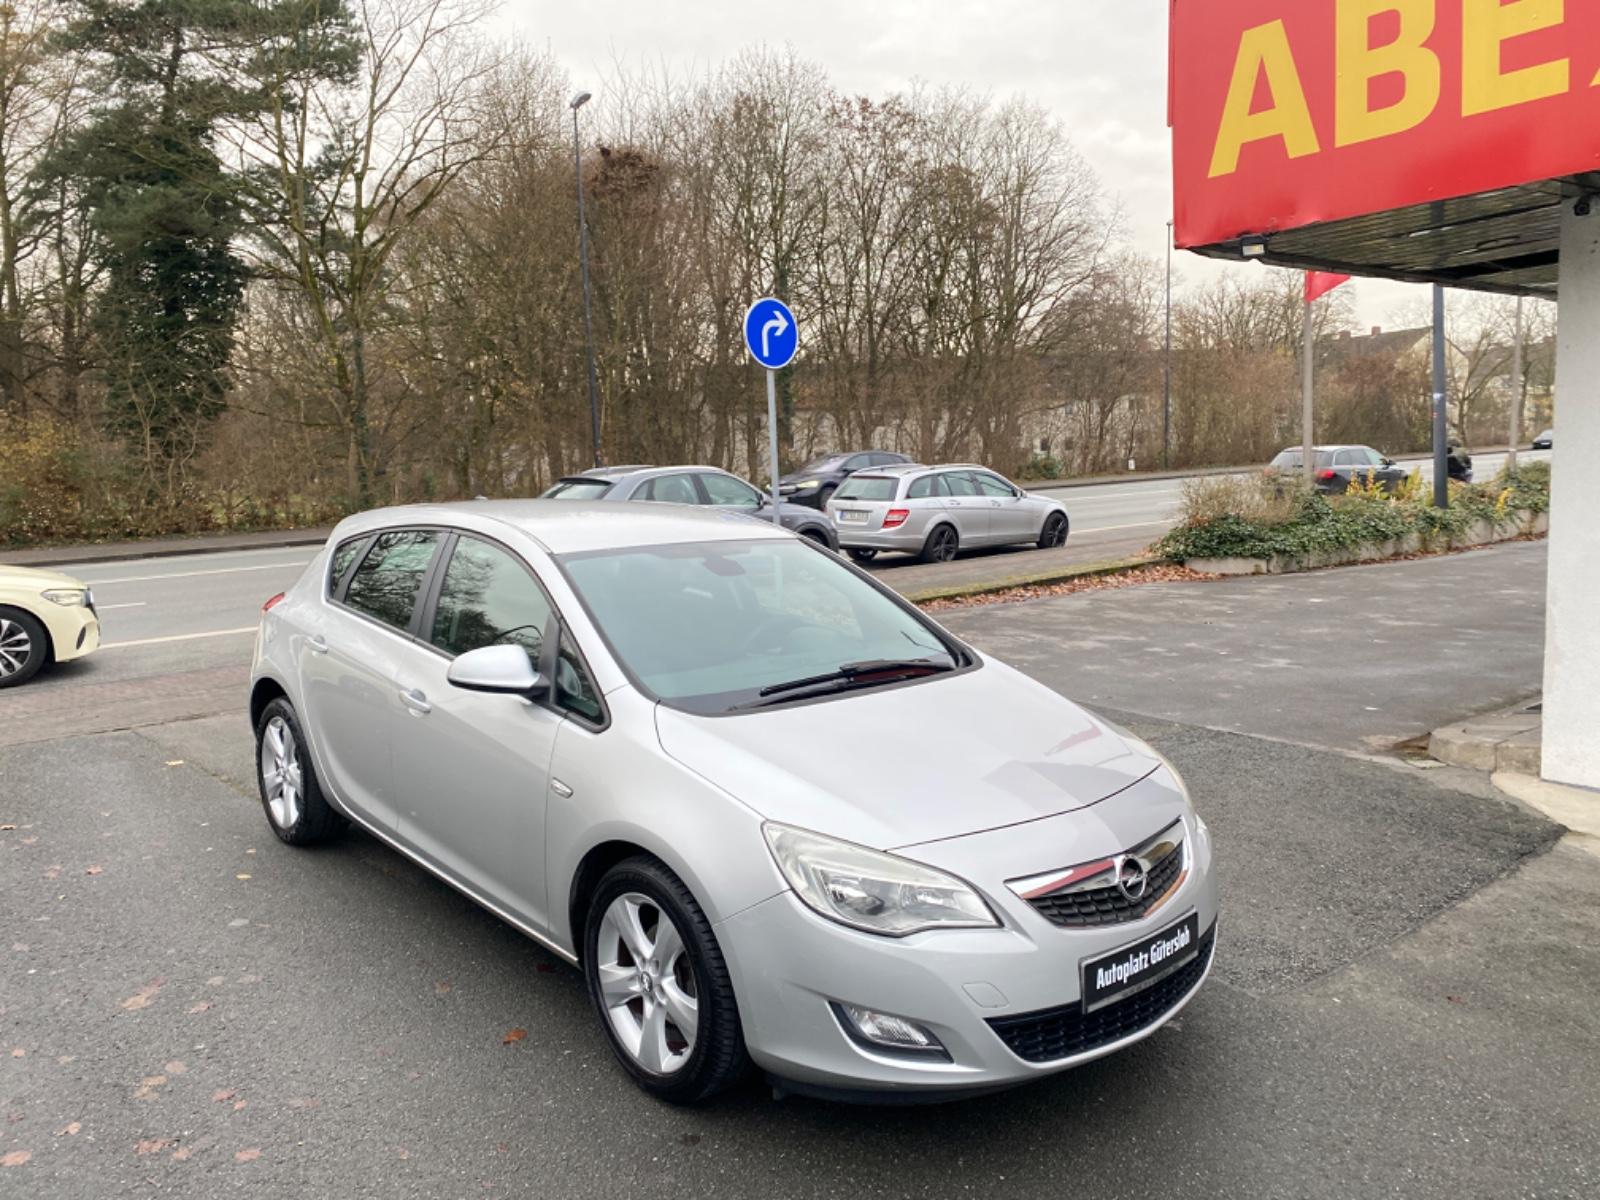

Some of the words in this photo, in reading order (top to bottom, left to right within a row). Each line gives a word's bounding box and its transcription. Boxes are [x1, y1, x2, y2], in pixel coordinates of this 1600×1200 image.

[1207, 0, 1600, 179] ABE
[1097, 952, 1149, 989] Autoplatz
[1150, 925, 1190, 963] Gütersloh
